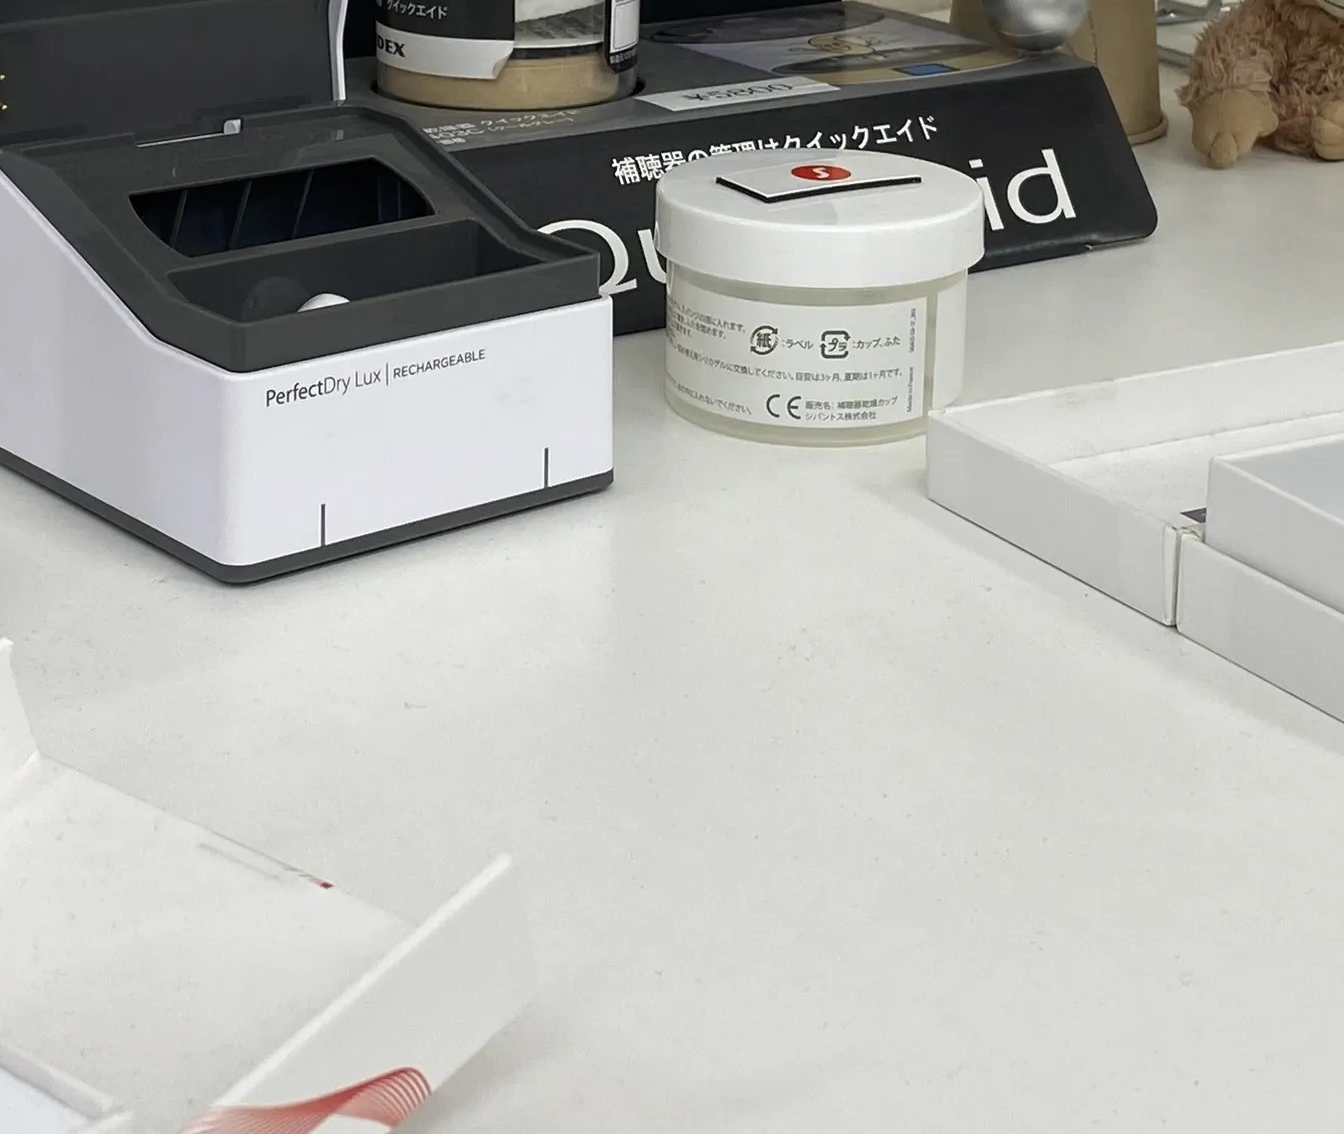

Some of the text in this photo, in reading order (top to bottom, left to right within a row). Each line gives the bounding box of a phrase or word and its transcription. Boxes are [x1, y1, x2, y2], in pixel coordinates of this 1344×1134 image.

[757, 332, 772, 349] 紙
[827, 337, 848, 353] プラ
[265, 348, 486, 407] PerfectDry Lux RECHARGEABLE
[766, 393, 802, 420] CE
